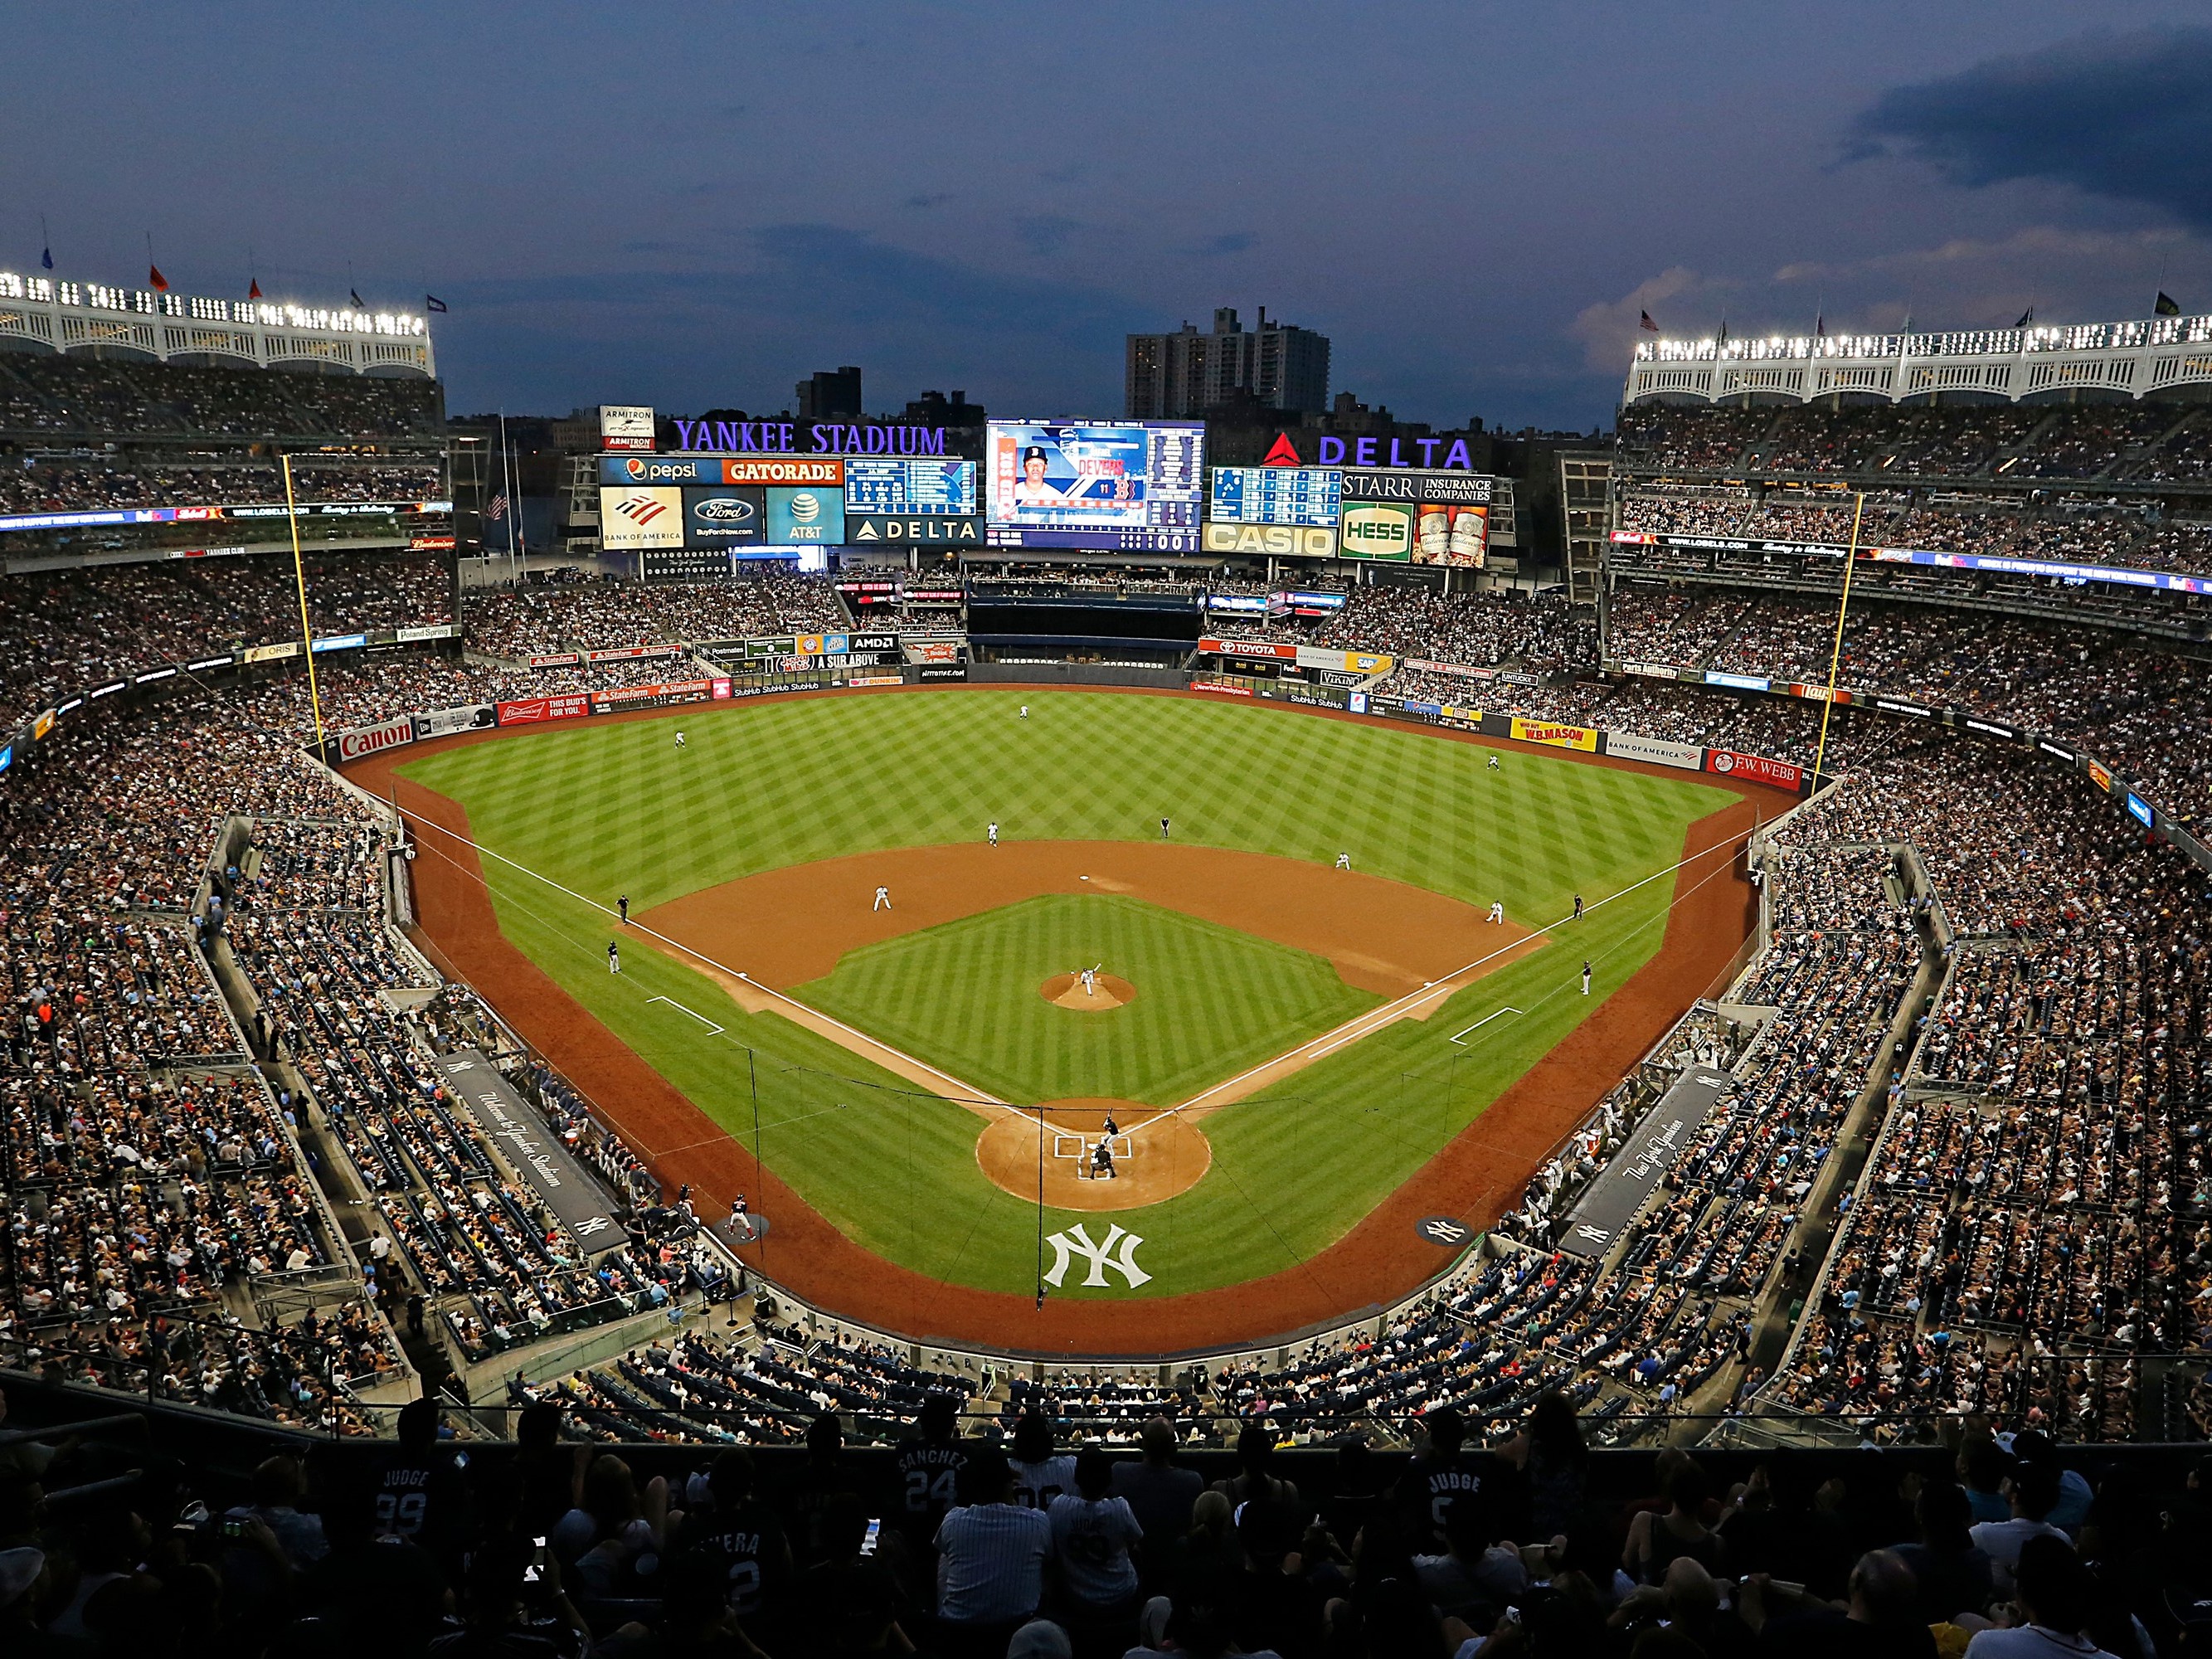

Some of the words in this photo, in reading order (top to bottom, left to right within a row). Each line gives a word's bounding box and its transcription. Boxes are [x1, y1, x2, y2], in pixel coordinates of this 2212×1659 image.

[606, 411, 651, 419] ARMITRON
[673, 420, 795, 452] YANKEE
[811, 424, 946, 455] STADIUM
[1319, 436, 1472, 469] DELTA
[650, 462, 697, 480] pepsi
[999, 452, 1014, 476] SOX
[1079, 460, 1125, 475] DEVERS
[730, 464, 836, 480] GATORADE
[1217, 476, 1223, 484] 2
[1343, 476, 1416, 498] STARR
[1426, 479, 1491, 490] INSURANCE
[1424, 489, 1490, 500] COMPANIES
[706, 502, 742, 518] Ford
[697, 528, 753, 537] BuyFordNow.com
[790, 527, 822, 539] AT&T
[887, 522, 976, 539] DELTA
[1348, 522, 1405, 541] HESS
[412, 540, 455, 548] Budweiser
[1157, 535, 1169, 550] 0
[1171, 535, 1183, 550] 0
[1189, 536, 1195, 551] 1
[1207, 524, 1334, 556] CASIO
[1667, 538, 1748, 549] WWW.LOBELS.COM
[207, 547, 230, 556] YANKEES
[401, 629, 425, 640] Poland
[425, 626, 450, 638] Spring
[268, 645, 290, 654] ORIS
[855, 637, 882, 648] AMD
[1237, 644, 1276, 655] TOYOTA
[818, 656, 825, 669] A
[828, 655, 847, 667] SUB
[848, 654, 879, 666] ABOVE
[1283, 664, 1301, 673] FedEx
[1357, 659, 1373, 669] SAP
[1622, 663, 1642, 673] Parts
[1643, 665, 1678, 677] Authority
[869, 676, 902, 685] DUNKIN'
[1323, 672, 1361, 687] VIKING
[735, 688, 761, 697] StubHub
[762, 685, 789, 693] StubHub
[790, 683, 819, 691] StubHub
[1197, 684, 1250, 695] NewYork-Presbyterian
[549, 700, 565, 708] THIS
[566, 697, 586, 707] BUD'S
[1291, 695, 1316, 704] StubHub
[1318, 698, 1343, 709] StubHub
[506, 708, 541, 718] Budweiser
[549, 708, 563, 717] FOR
[564, 706, 581, 715] YOU.
[342, 723, 411, 757] Canon
[1609, 742, 1630, 750] BANK
[1643, 747, 1680, 758] AMERICA
[1735, 757, 1757, 771] F.W.
[1759, 761, 1795, 781] WEBB
[496, 1125, 537, 1156] Yankee
[527, 1151, 562, 1188] Stadium
[1622, 1163, 1650, 1180] New
[1636, 1142, 1665, 1168] York
[1655, 1119, 1685, 1151] Yankees
[1043, 1223, 1153, 1289] NY
[898, 1449, 969, 1472] SANCHEZ
[384, 1469, 430, 1487] JUDGE
[1428, 1472, 1481, 1493] JUDGE
[905, 1469, 958, 1512] 24
[372, 1492, 427, 1535] 99
[729, 1559, 762, 1614] 2
